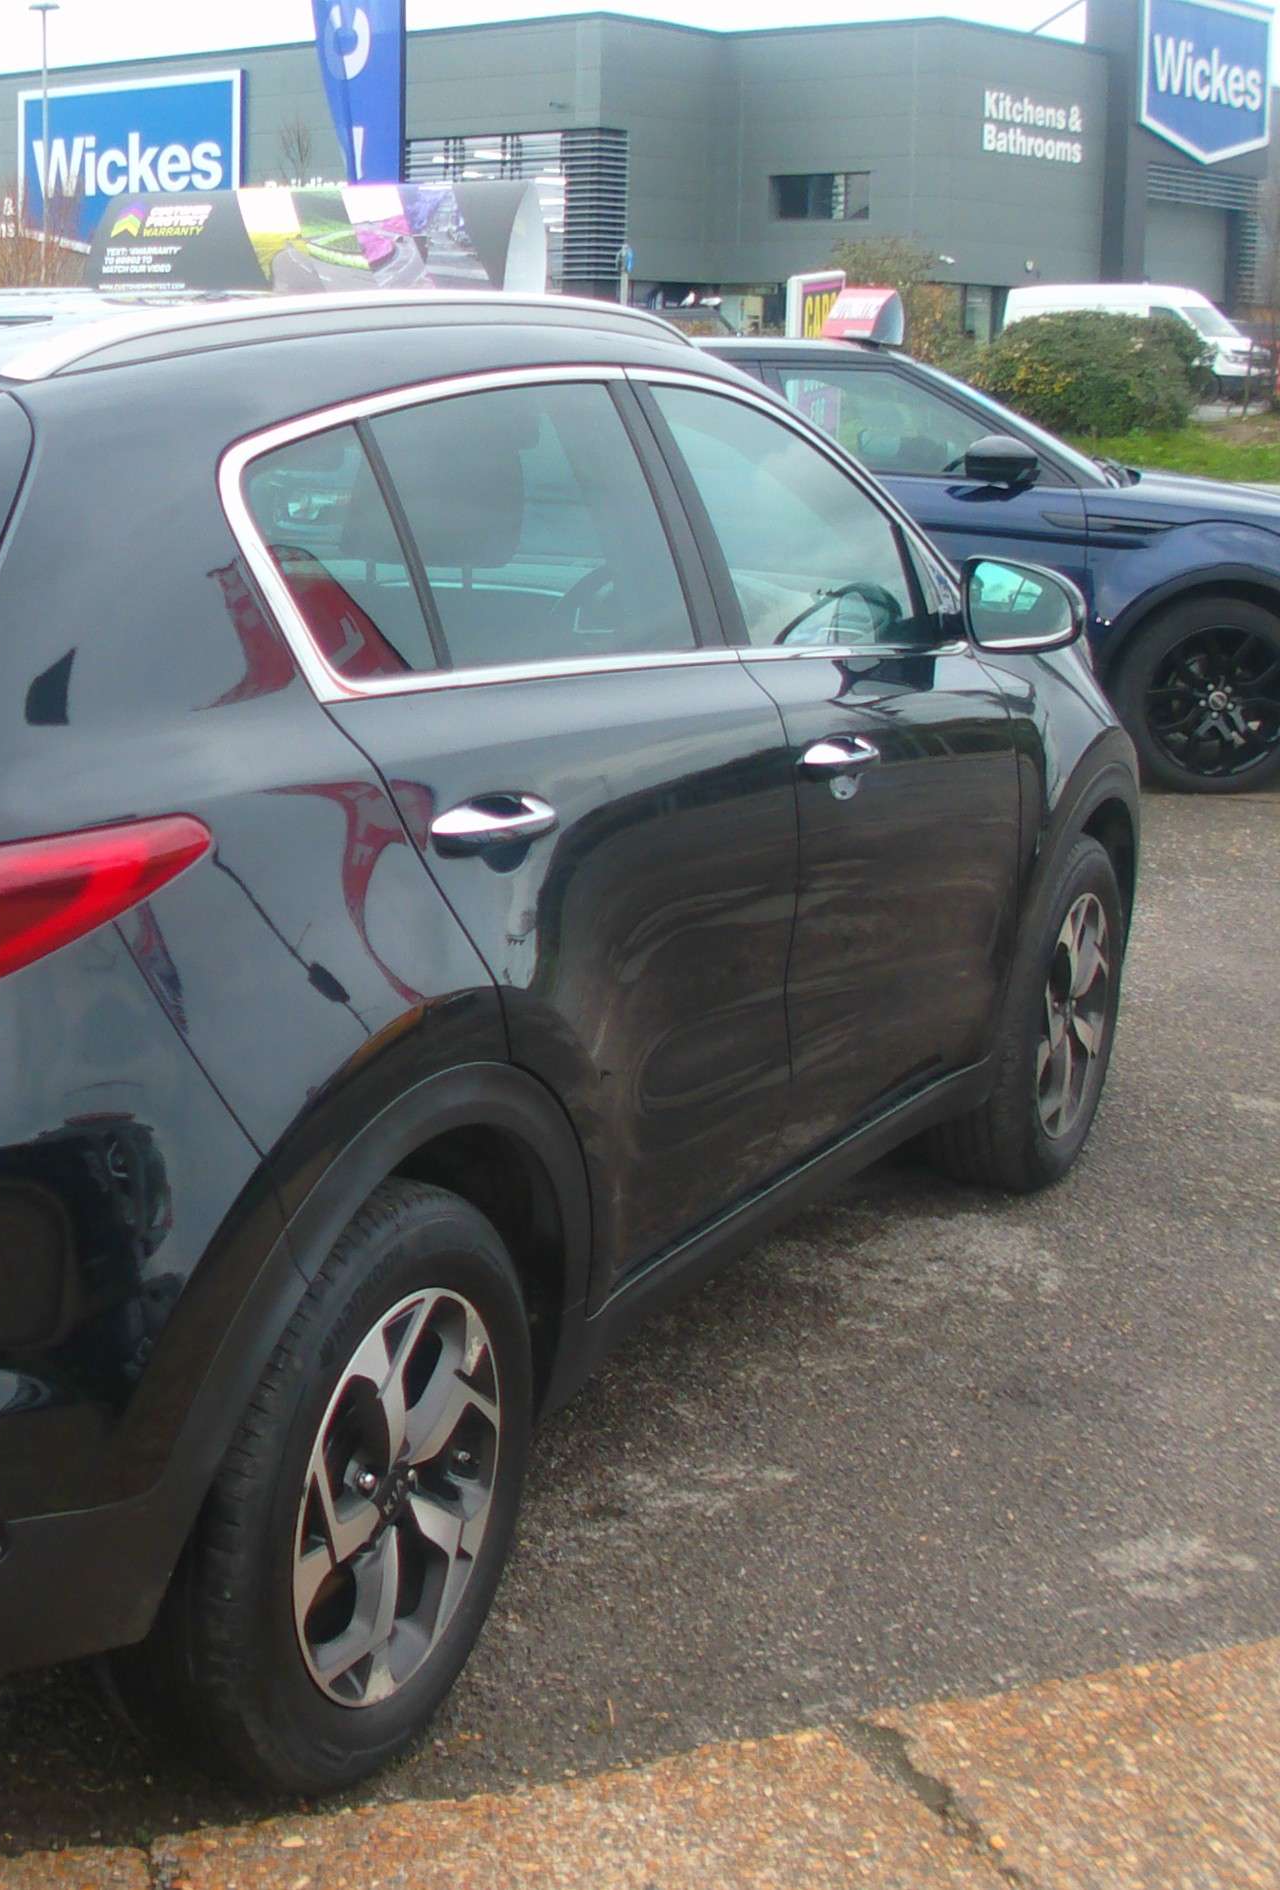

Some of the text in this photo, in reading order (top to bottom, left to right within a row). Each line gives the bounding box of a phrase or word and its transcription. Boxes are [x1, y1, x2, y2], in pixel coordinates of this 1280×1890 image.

[1153, 33, 1262, 112] Wickes
[984, 90, 1082, 133] Kitchens &
[983, 122, 1082, 164] Bathrooms
[32, 132, 223, 199] Wickes
[3, 197, 16, 217] &
[143, 225, 205, 237] WARRANTY
